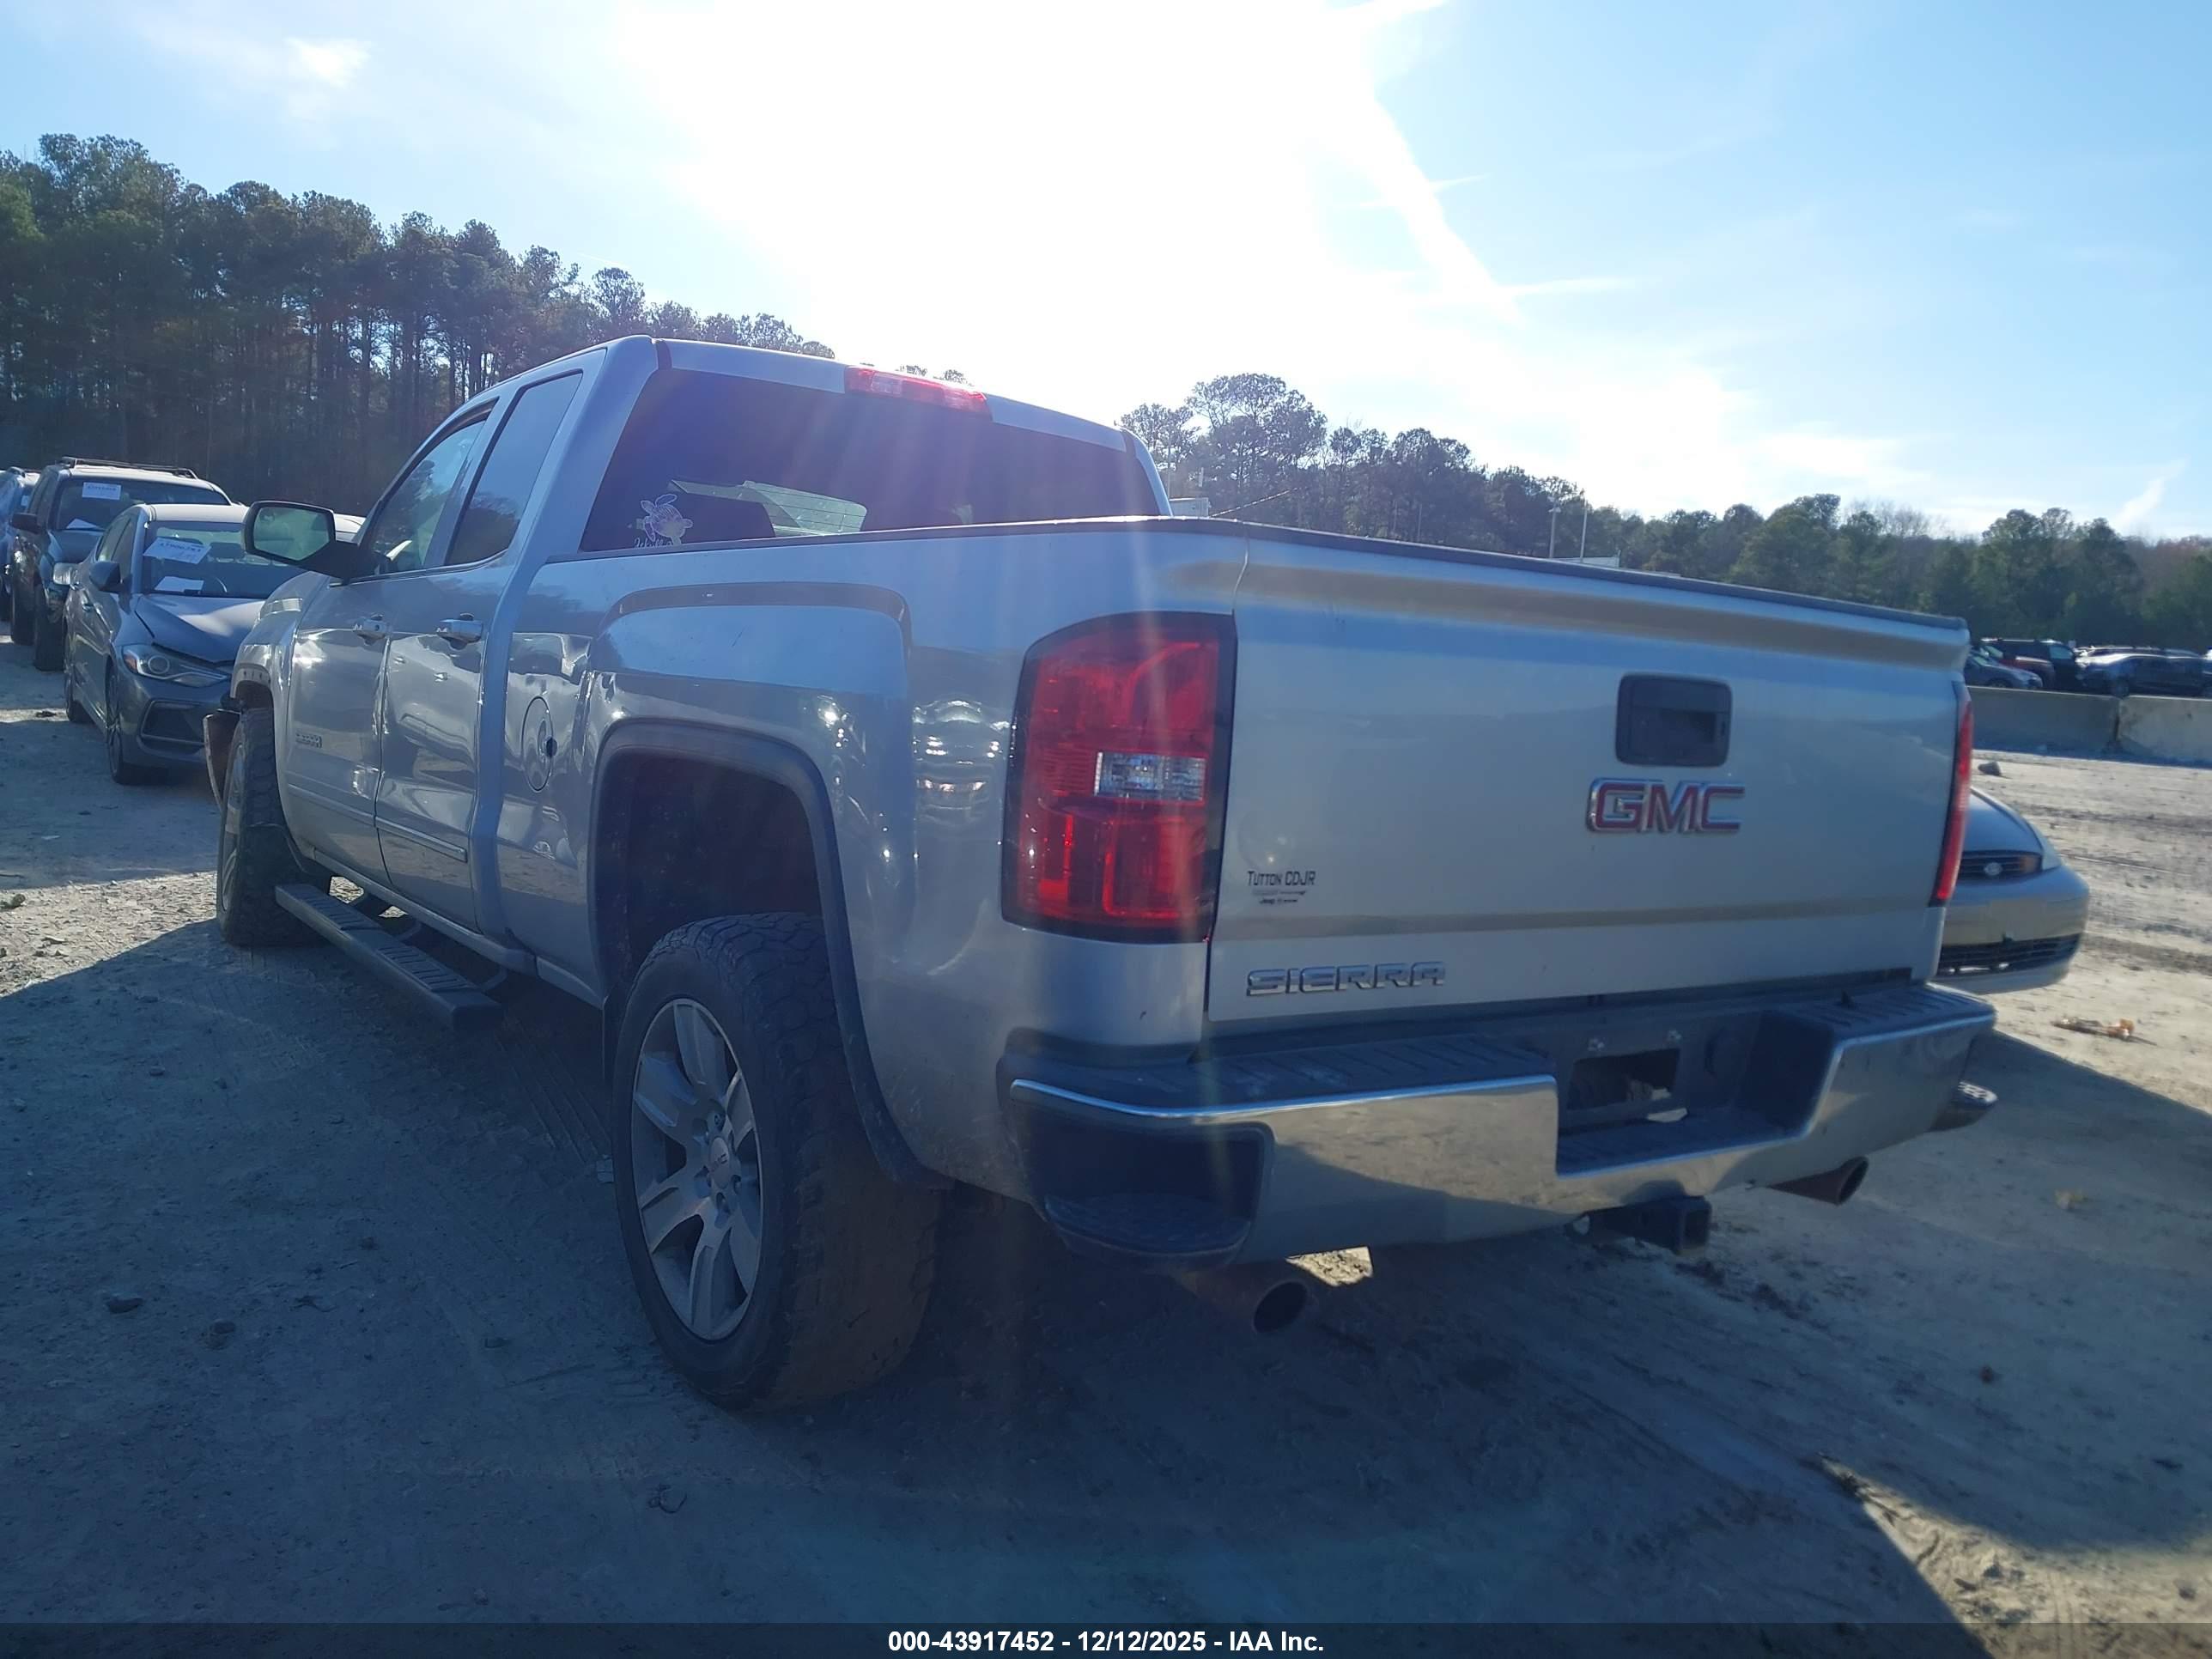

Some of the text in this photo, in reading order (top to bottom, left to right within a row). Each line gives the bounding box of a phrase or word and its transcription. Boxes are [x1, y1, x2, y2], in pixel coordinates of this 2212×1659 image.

[1586, 777, 1745, 834] GMC
[1248, 871, 1316, 885] TUTTON CDJR
[1247, 961, 1445, 997] SIERRA
